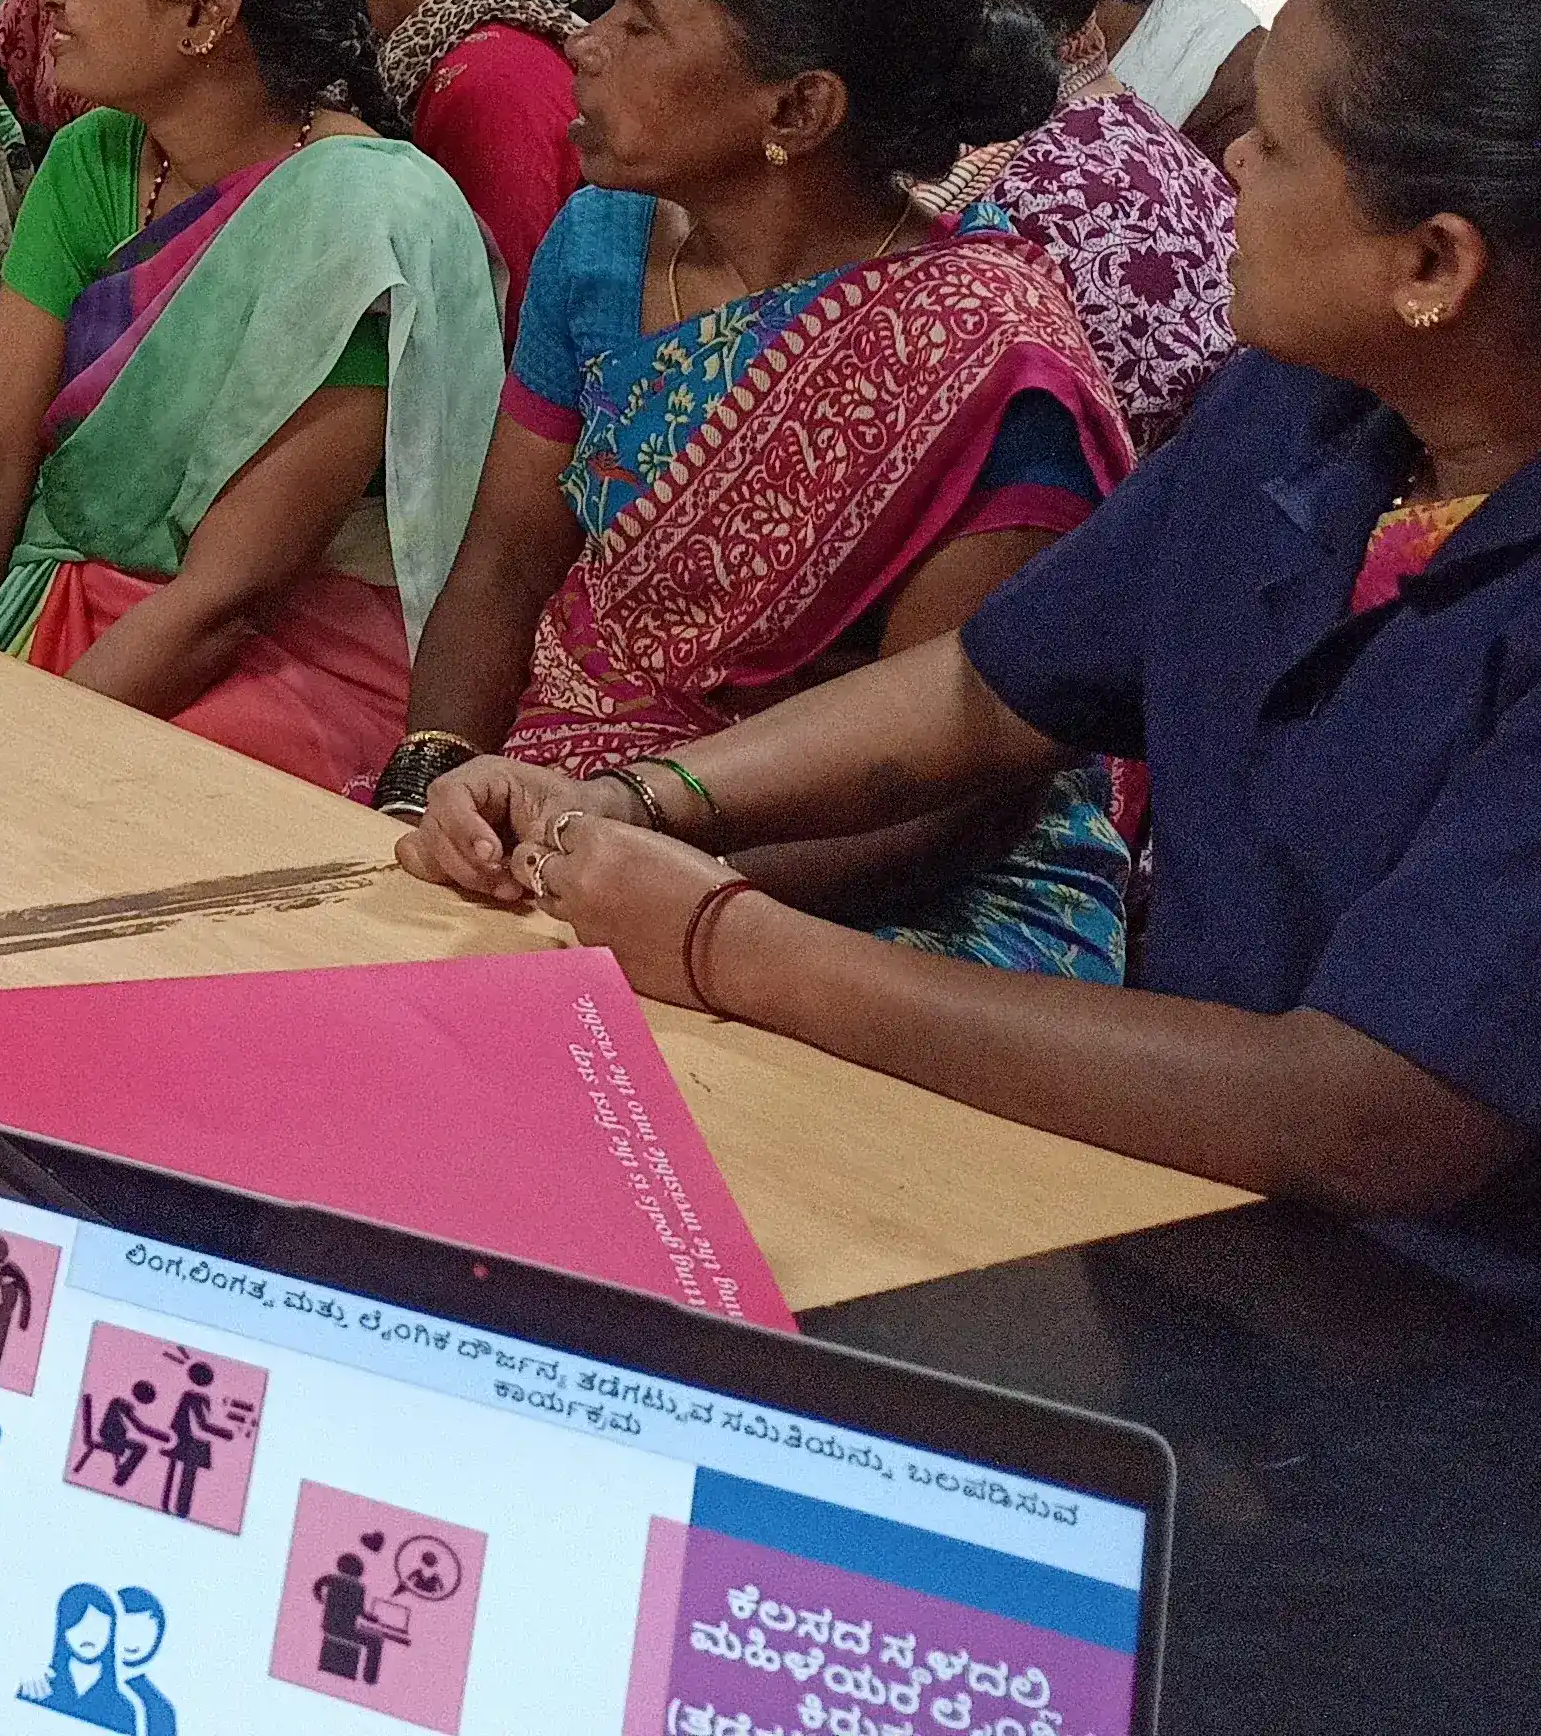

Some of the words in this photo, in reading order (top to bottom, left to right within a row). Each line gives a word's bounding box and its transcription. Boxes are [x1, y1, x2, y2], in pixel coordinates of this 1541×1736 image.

[569, 1043, 599, 1085] step
[607, 1063, 636, 1095] the
[588, 1090, 631, 1137] first
[628, 1100, 658, 1142] into
[608, 1135, 638, 1168] the
[627, 1171, 651, 1190] is
[644, 1146, 701, 1232] invisible
[635, 1194, 686, 1252] goals
[689, 1236, 721, 1270] the
[283, 1290, 349, 1329] ಮತ್ತು
[358, 1308, 453, 1351] ಲೈಂಗಿಕ
[575, 1370, 714, 1426] ತಡೆಗಟ್ಟುವ
[721, 1410, 896, 1480] ಸಮಿತಿಯನ್ನು
[906, 1462, 1080, 1527] ಬಲಪಡಿಸುವ
[493, 1378, 643, 1437] ಕಾರ್ಯಕ್ರಮ
[689, 1620, 921, 1715] ಮಹಿಳೆಯರ
[725, 1583, 873, 1656] ಕೆಲಸದ
[879, 1631, 1063, 1726] ಸ್ಥಳದಲ್ಲಿ
